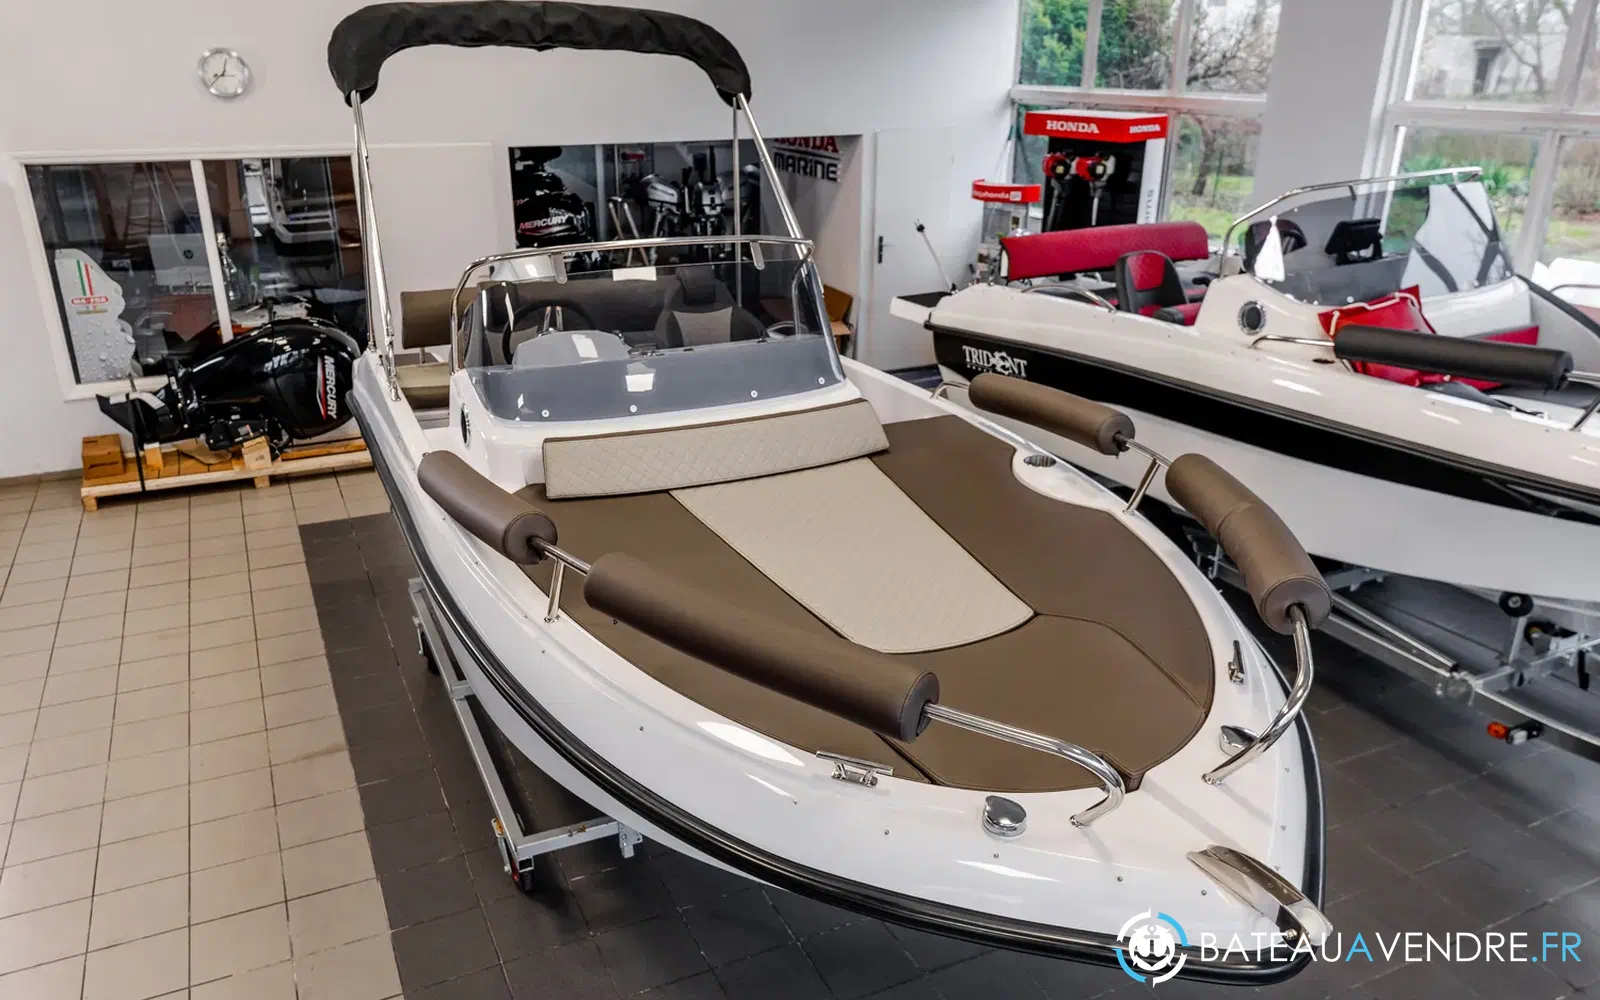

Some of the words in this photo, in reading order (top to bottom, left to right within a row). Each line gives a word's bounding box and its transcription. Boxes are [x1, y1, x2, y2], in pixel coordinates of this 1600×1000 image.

[1046, 120, 1099, 133] HONDA
[1129, 124, 1160, 133] HONDA
[774, 152, 838, 181] MARINE
[519, 214, 569, 229] MERCURY
[962, 345, 1027, 377] TRIDENT
[324, 355, 337, 419] MERCURY
